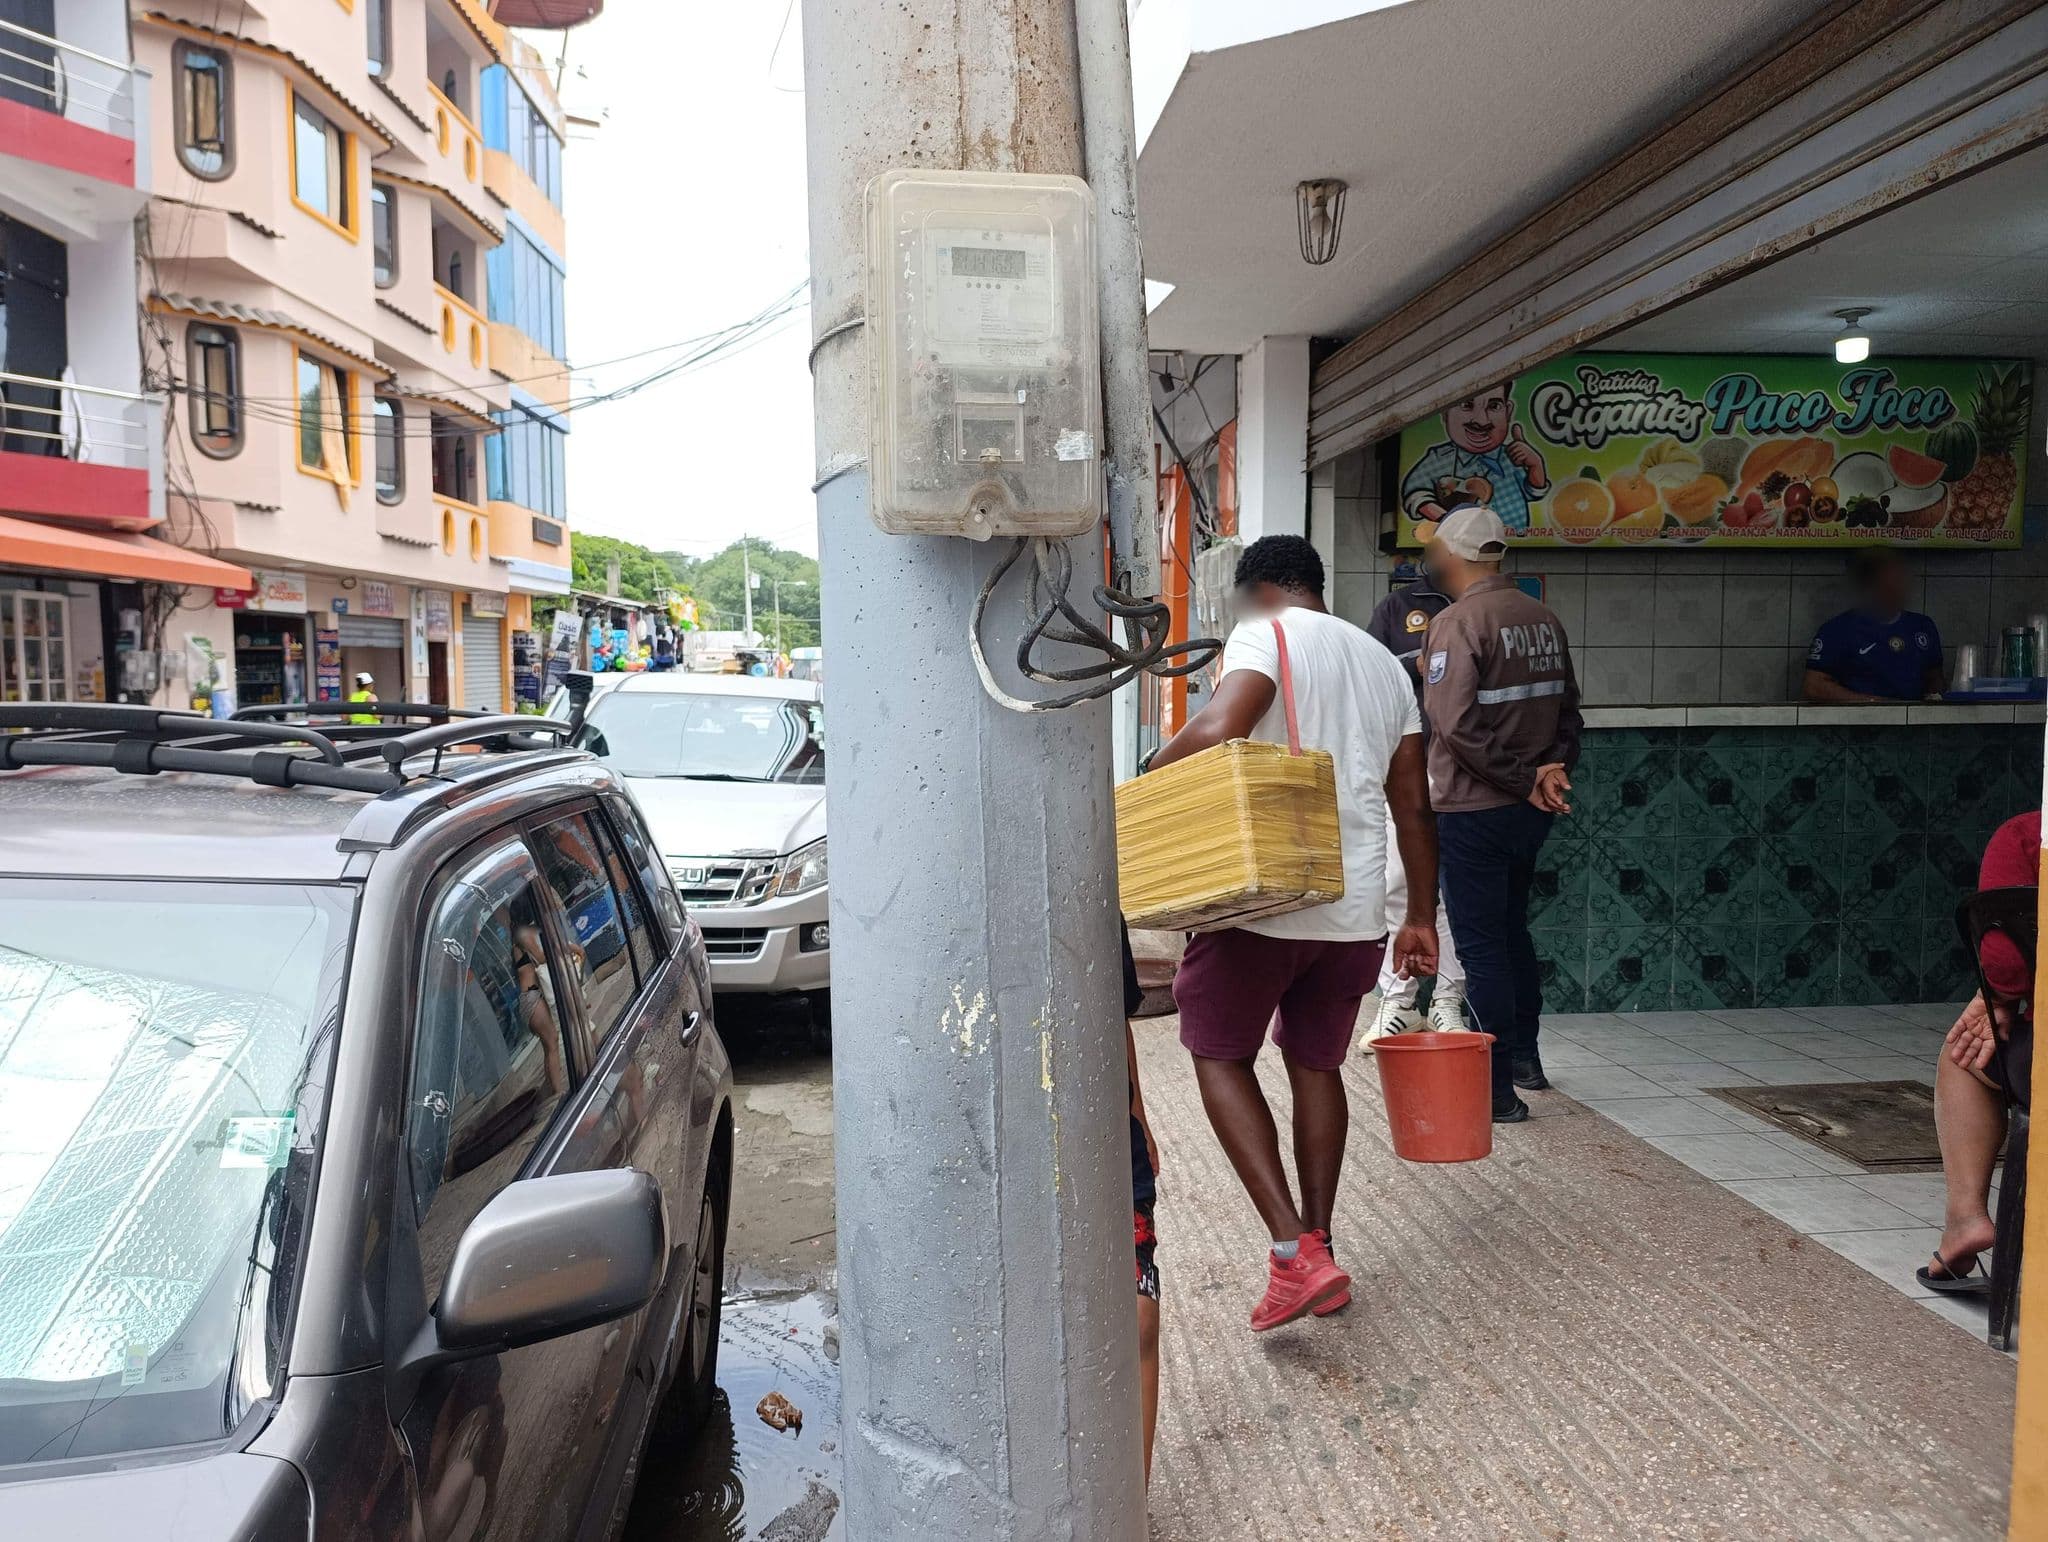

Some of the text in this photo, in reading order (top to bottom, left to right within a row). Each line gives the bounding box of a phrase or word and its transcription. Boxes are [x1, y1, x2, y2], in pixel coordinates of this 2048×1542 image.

[1579, 366, 1657, 394] Batidos
[1532, 383, 1705, 447] Gigantes
[1707, 373, 1834, 434] Paco
[1525, 527, 1554, 538] MORA
[1611, 527, 1660, 538] FRUTILLA
[1668, 527, 1711, 538] BANANO
[1718, 527, 1767, 538] NARANJA
[1775, 527, 1839, 539] NARANJILLA
[1849, 527, 1886, 539] TOMATE
[1888, 527, 1901, 539] DE
[1946, 528, 1989, 540] GALLETA
[1991, 528, 2015, 540] OREO
[1500, 623, 1560, 660] POLICI
